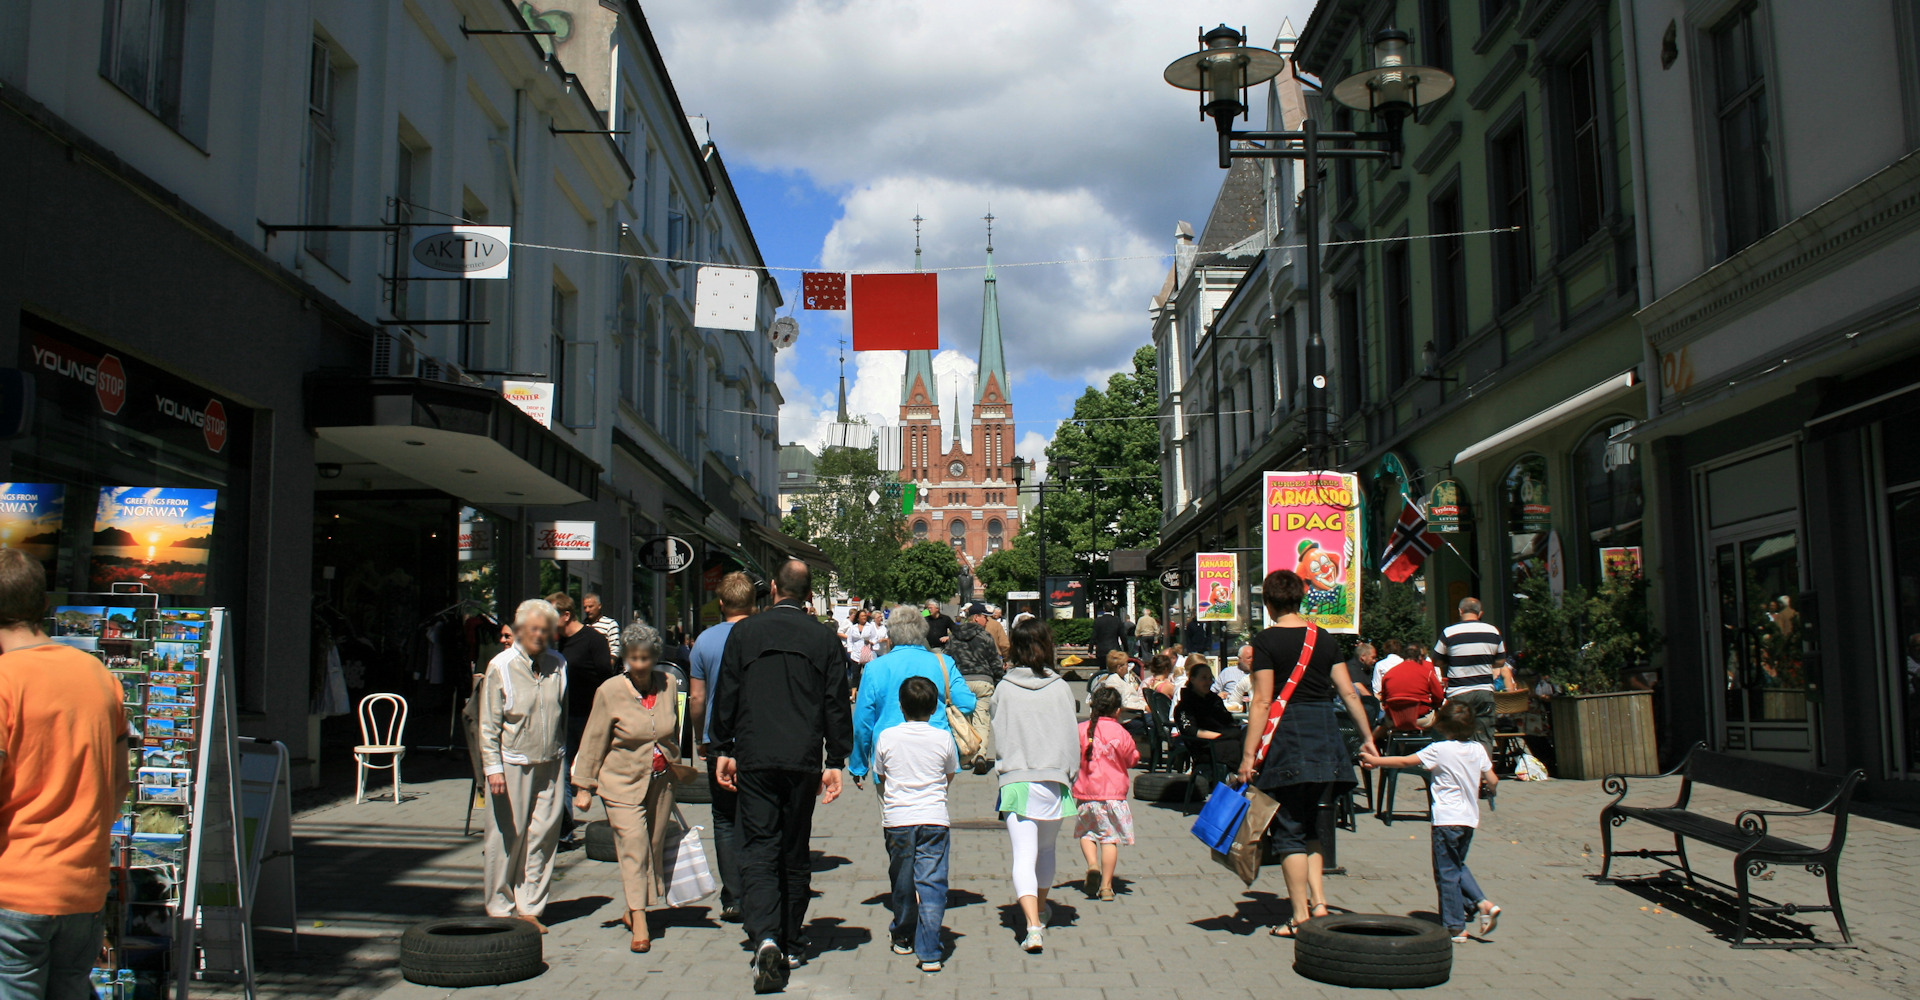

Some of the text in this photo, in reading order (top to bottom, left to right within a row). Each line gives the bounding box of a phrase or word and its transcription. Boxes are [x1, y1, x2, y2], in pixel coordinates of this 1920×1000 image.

[426, 238, 494, 258] AKTIV
[32, 344, 124, 397] YOUNG STOP
[155, 394, 226, 436] YOUNG STOP
[16, 493, 38, 501] FROM
[125, 497, 189, 506] GREETINGS FROM
[1269, 487, 1352, 507] ARNARDO
[123, 505, 188, 518] NORWAY
[1272, 512, 1343, 531] I DAG
[537, 529, 574, 541] Four
[541, 538, 591, 550] Seasons
[1200, 560, 1233, 568] ARNARDO
[1206, 571, 1230, 579] DAG
